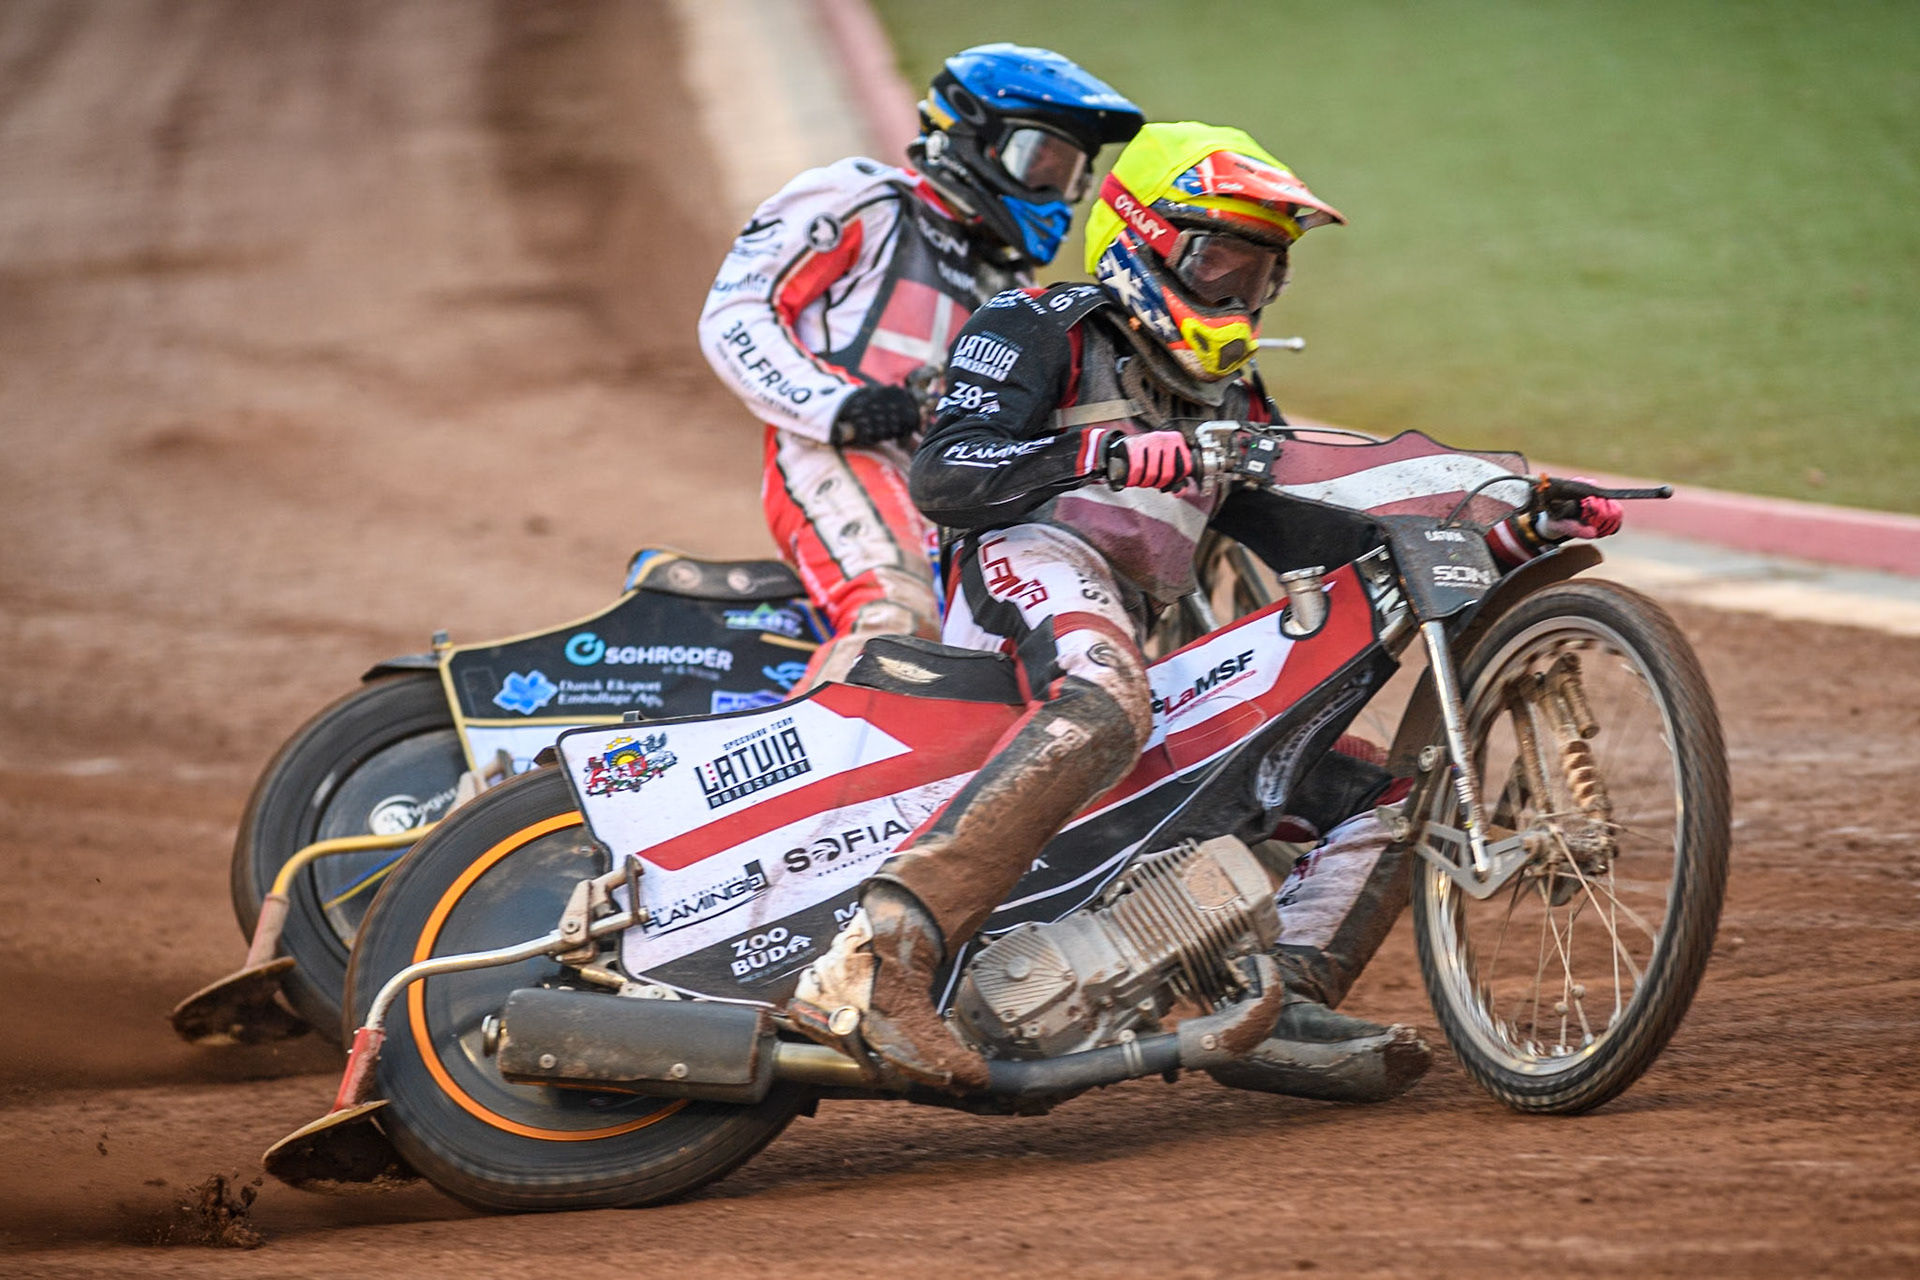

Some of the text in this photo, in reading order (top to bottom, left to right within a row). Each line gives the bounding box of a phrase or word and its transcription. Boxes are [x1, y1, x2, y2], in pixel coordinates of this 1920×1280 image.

[1114, 193, 1168, 240] OAKLEY
[953, 334, 1021, 373] LATVIA
[694, 726, 806, 796] LATVIA
[784, 820, 910, 873] SOFIA
[731, 927, 789, 958] ZOO
